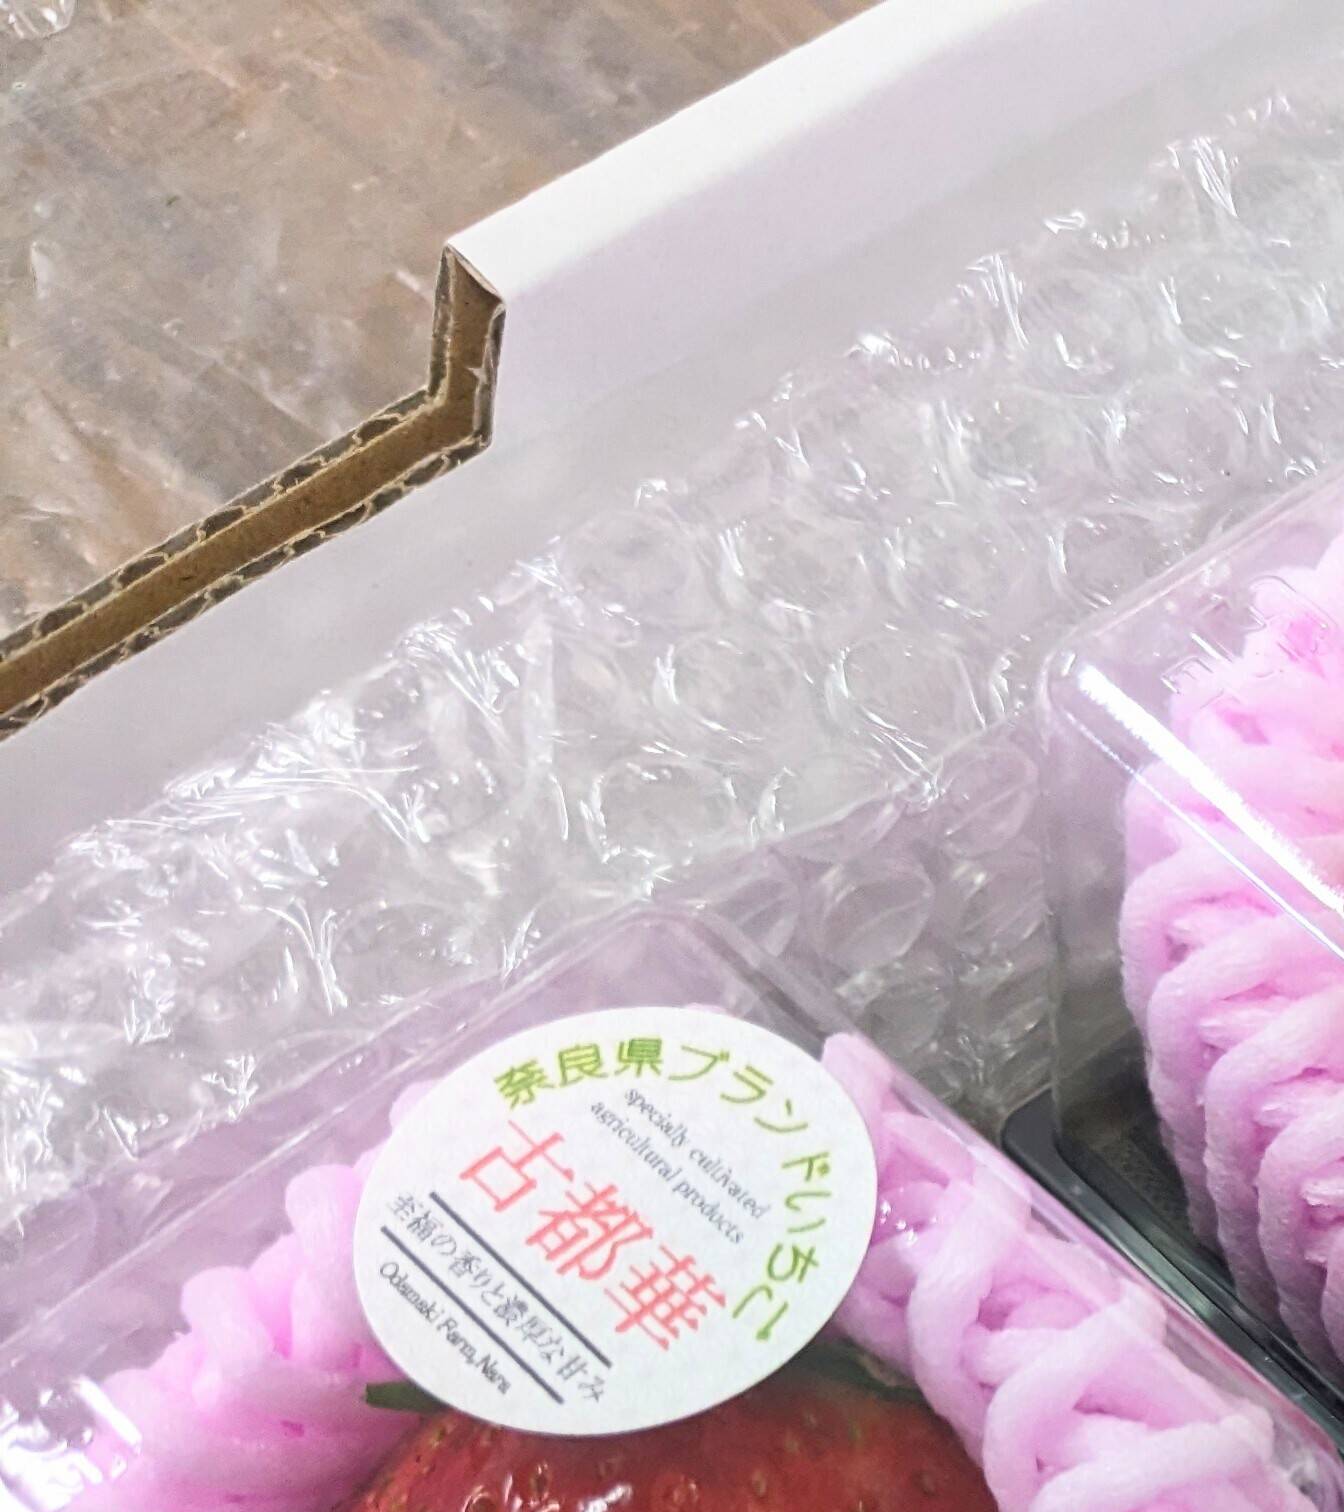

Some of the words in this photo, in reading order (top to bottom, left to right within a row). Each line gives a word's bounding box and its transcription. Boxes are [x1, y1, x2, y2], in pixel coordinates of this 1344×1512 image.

[458, 1121, 726, 1351] 古都華
[494, 1037, 832, 1342] 奈良県ブランドいちご
[590, 1101, 678, 1184] agricultural
[674, 1180, 744, 1244] products
[624, 1088, 690, 1147] specially
[688, 1147, 771, 1219] cultivated
[379, 1262, 447, 1325] Odamaki
[390, 1193, 608, 1403] 至福の香りと濃厚な甘み
